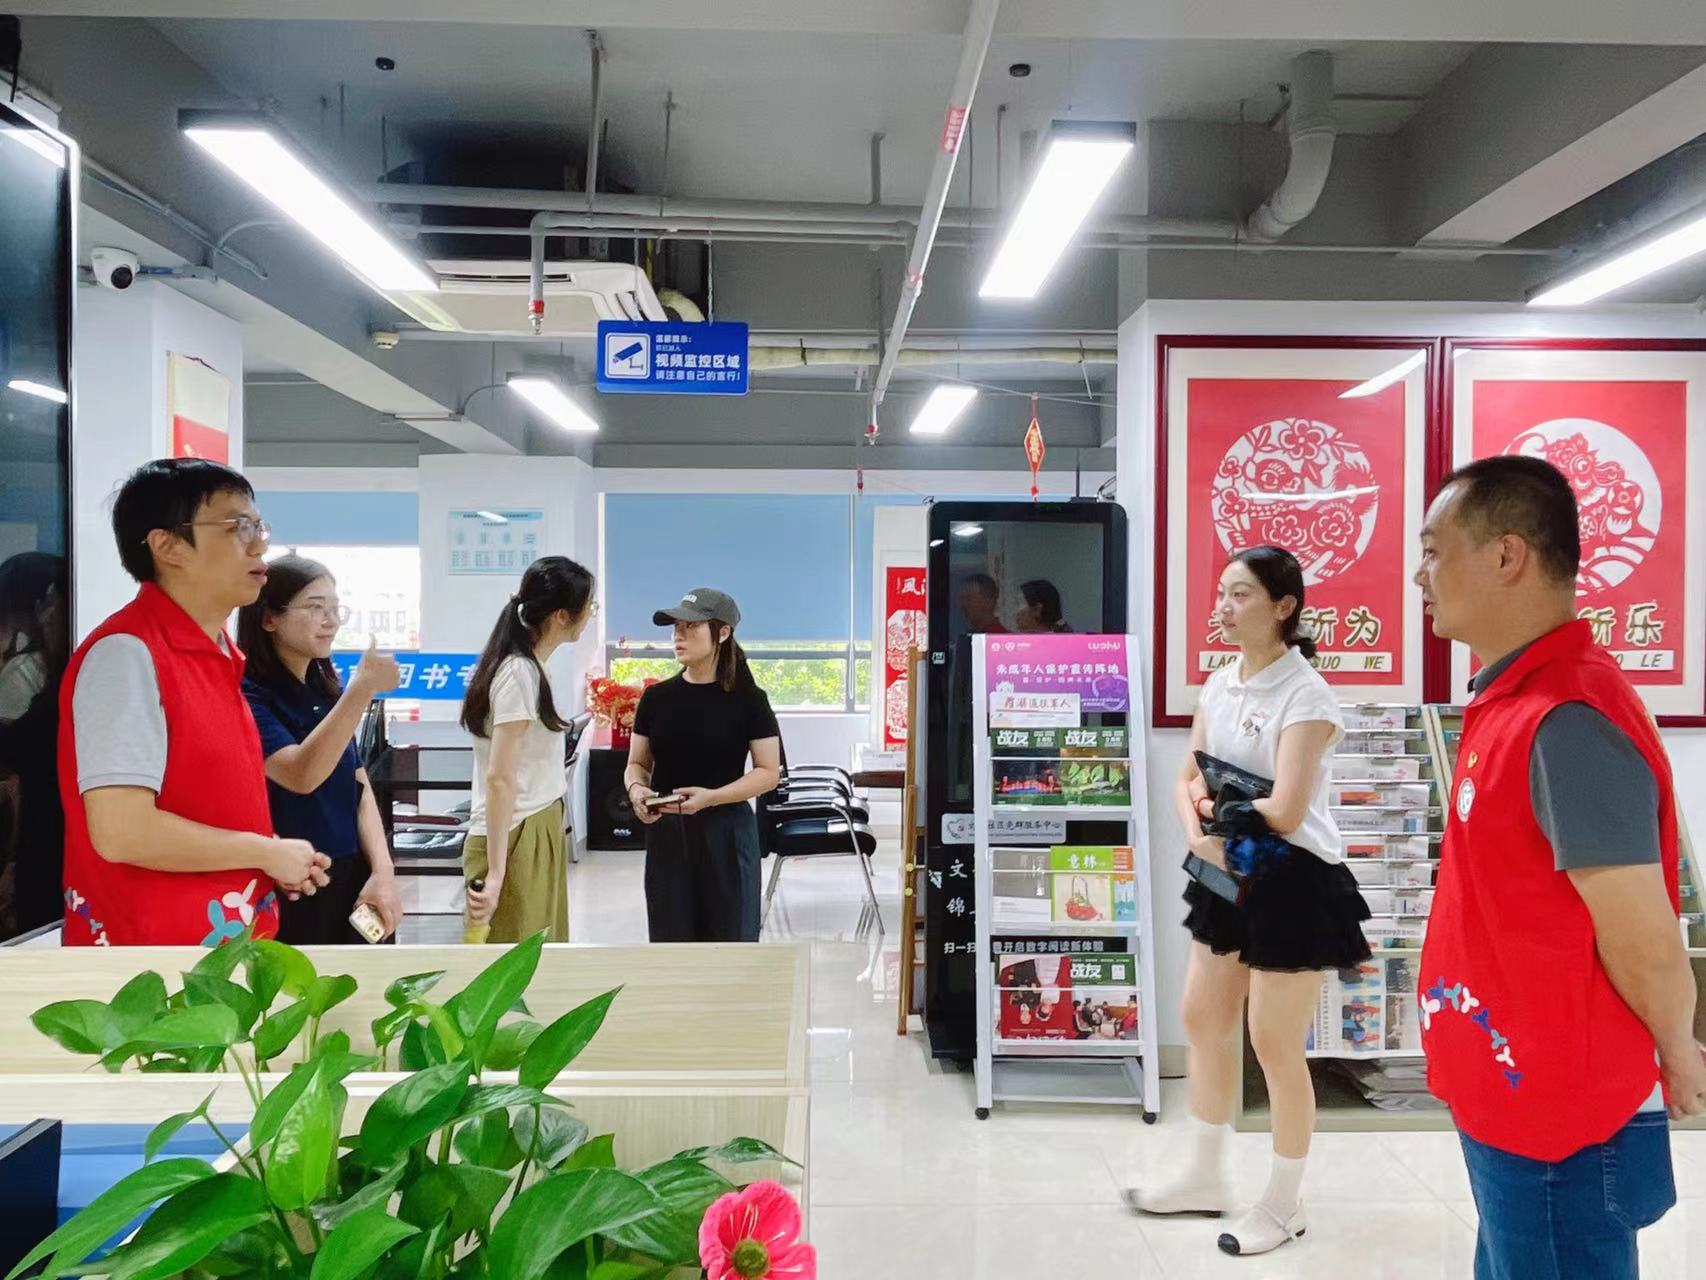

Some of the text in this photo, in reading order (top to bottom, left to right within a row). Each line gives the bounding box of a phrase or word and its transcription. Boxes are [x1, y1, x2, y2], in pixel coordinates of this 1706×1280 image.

[655, 354, 741, 369] 视频监控区域
[1640, 653, 1664, 668] LE
